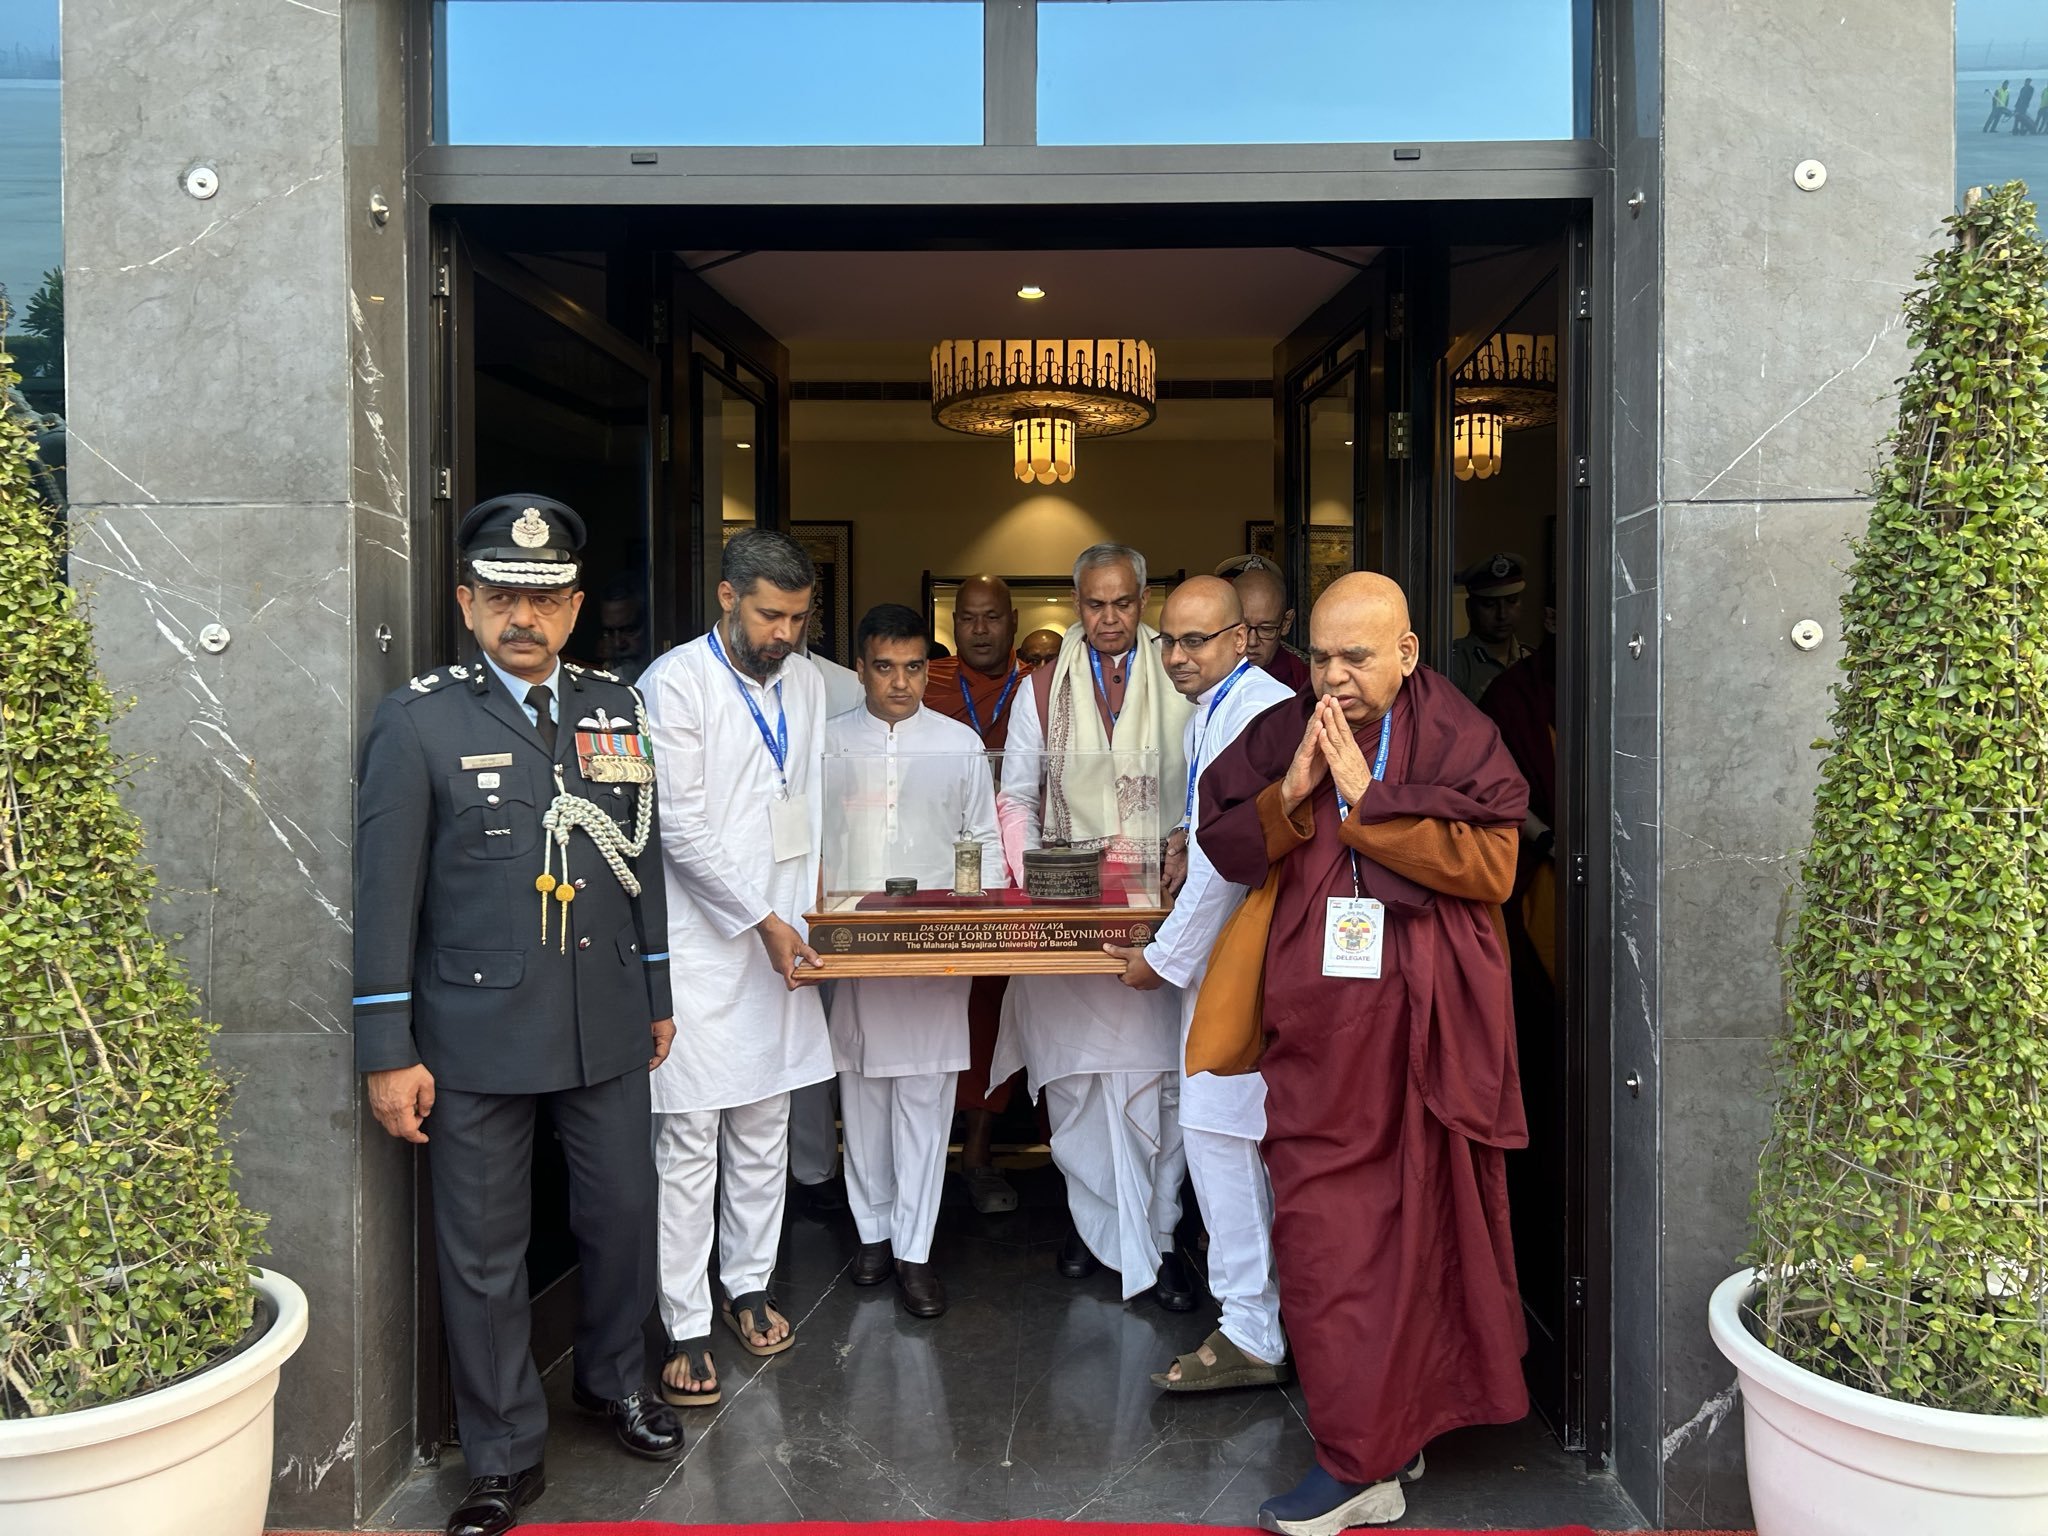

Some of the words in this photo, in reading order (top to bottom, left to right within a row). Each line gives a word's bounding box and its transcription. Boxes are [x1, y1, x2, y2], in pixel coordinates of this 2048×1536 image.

[1028, 922, 1064, 930] NILAYA
[857, 932, 890, 942] HOLY
[893, 931, 935, 941] RELICS
[938, 931, 955, 941] OF
[959, 931, 992, 941] LORD
[995, 930, 1051, 941] BUDDHA,
[1055, 929, 1127, 939] DEVNIMORI
[906, 941, 921, 949] The
[923, 941, 959, 950] Maharaja
[961, 941, 997, 950] Sayajirao
[999, 940, 1037, 949] University
[1039, 940, 1048, 948] of
[1050, 939, 1078, 947] Baroda
